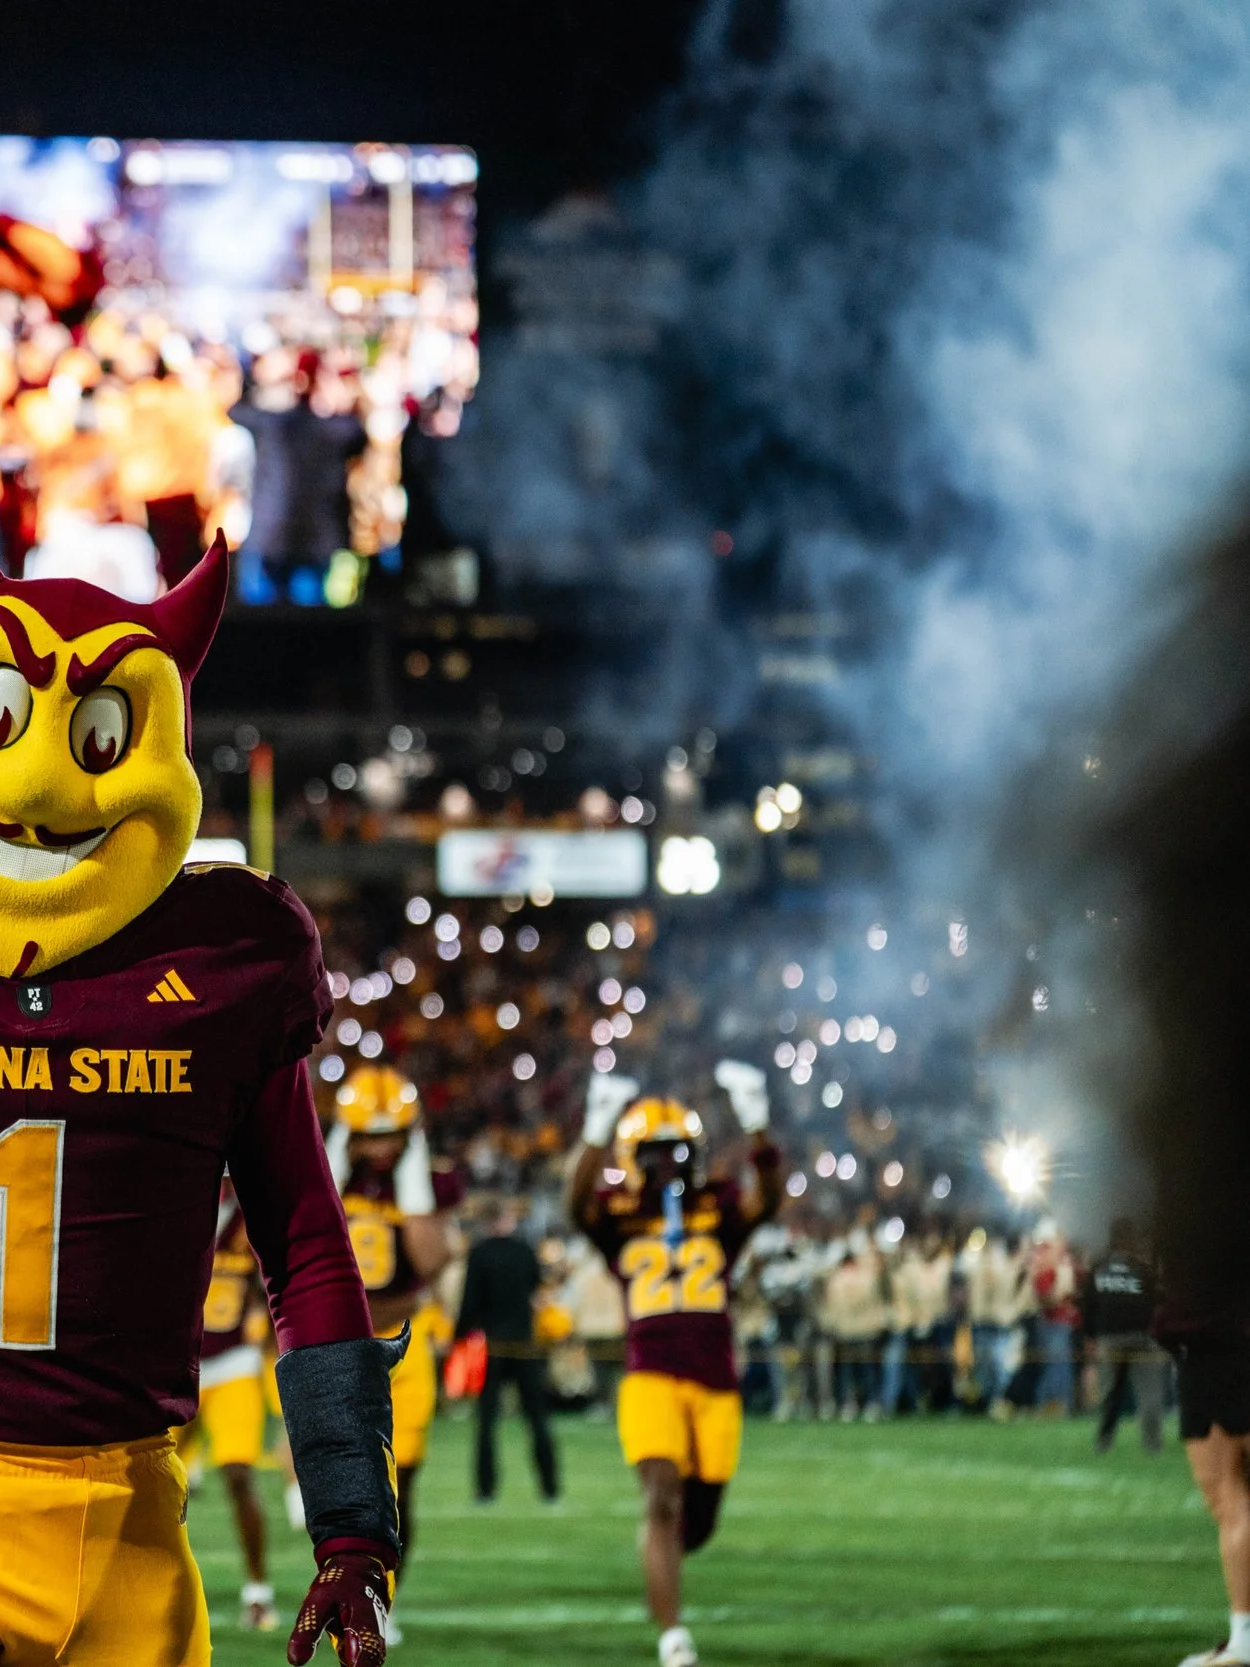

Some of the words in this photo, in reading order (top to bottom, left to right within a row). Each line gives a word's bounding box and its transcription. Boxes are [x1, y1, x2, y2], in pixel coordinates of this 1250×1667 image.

[27, 988, 41, 999] PT
[29, 1001, 44, 1012] 42
[68, 1047, 193, 1094] STATE
[619, 1237, 727, 1320] 22
